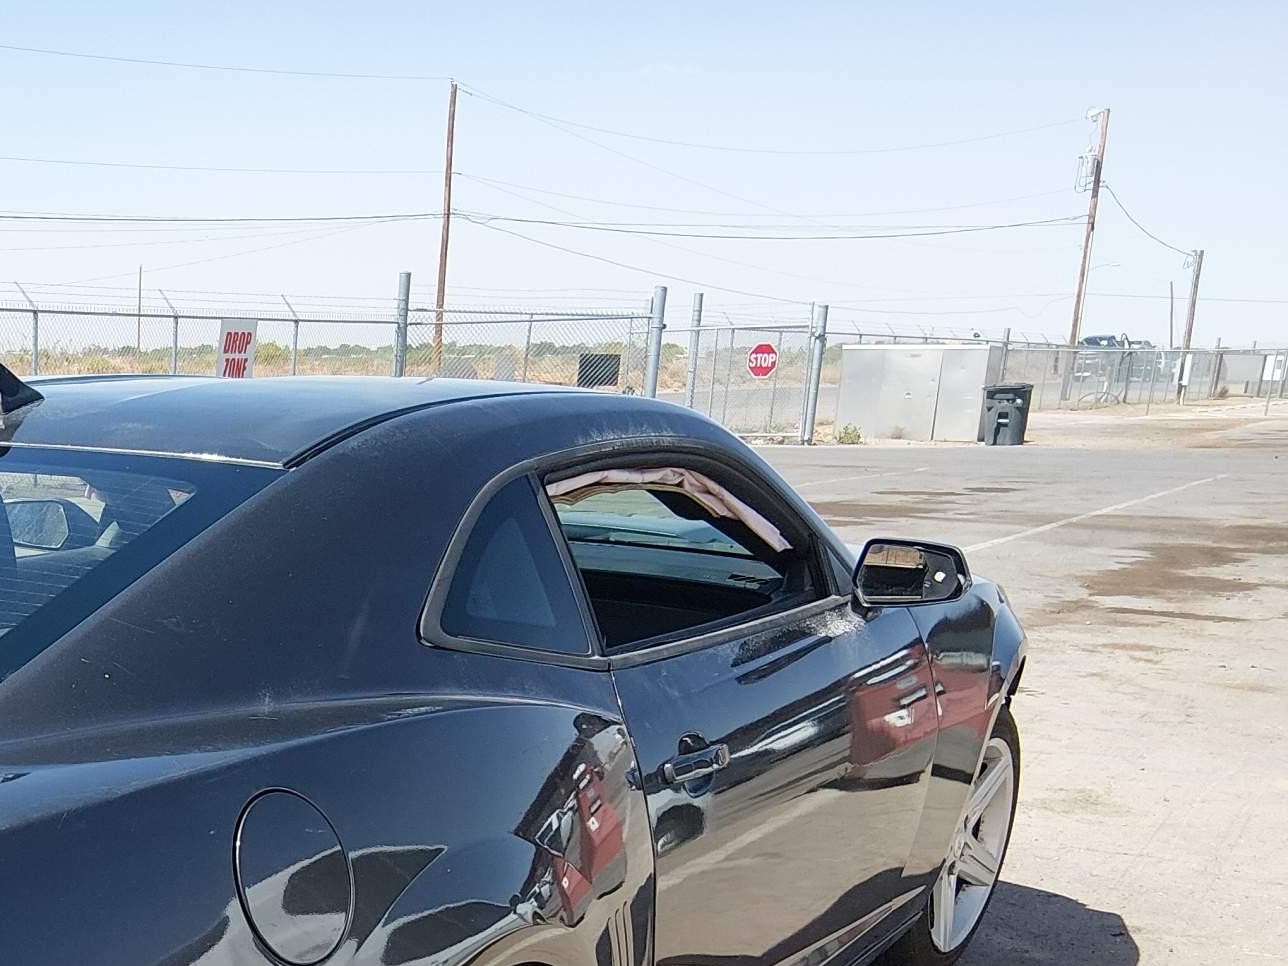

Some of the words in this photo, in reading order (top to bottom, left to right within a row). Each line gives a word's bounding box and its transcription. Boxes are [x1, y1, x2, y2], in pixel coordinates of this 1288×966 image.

[223, 331, 252, 354] DROP
[223, 357, 248, 379] ZONE
[749, 352, 776, 368] STOP
